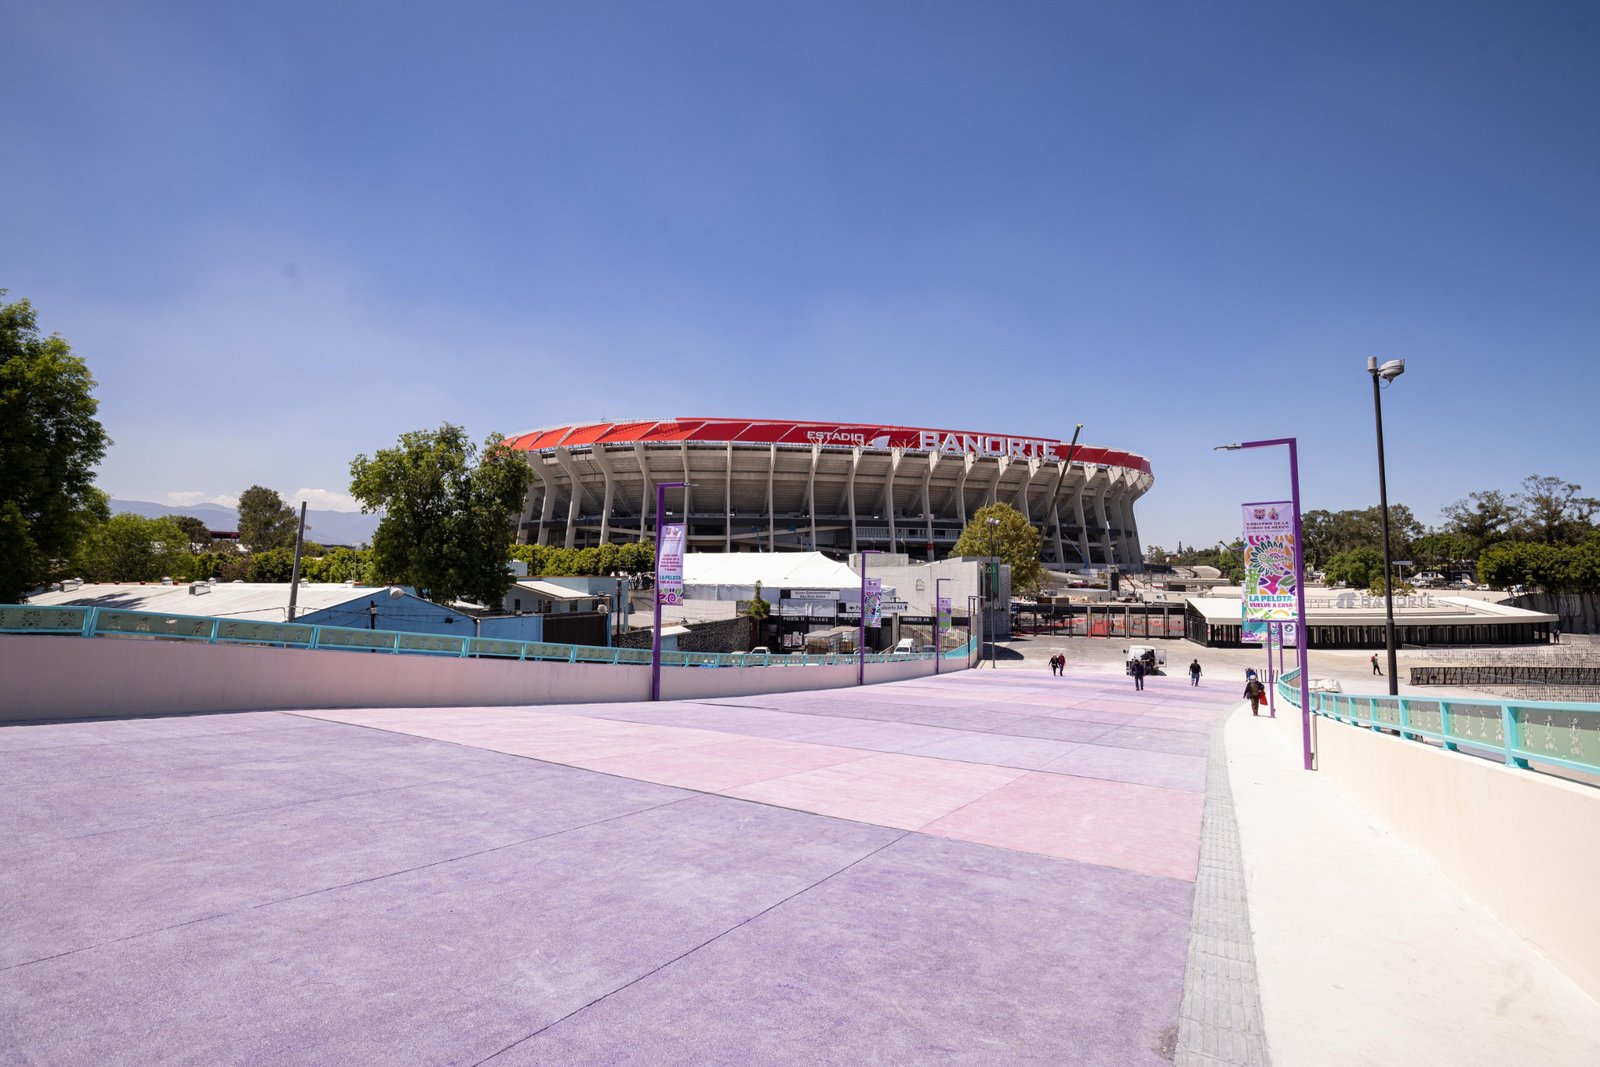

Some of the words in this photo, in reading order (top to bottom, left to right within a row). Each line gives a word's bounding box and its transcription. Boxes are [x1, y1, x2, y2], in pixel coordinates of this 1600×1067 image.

[808, 431, 864, 442] ESTADIO
[920, 432, 1060, 462] BANORTE
[1361, 596, 1435, 608] BAORTE
